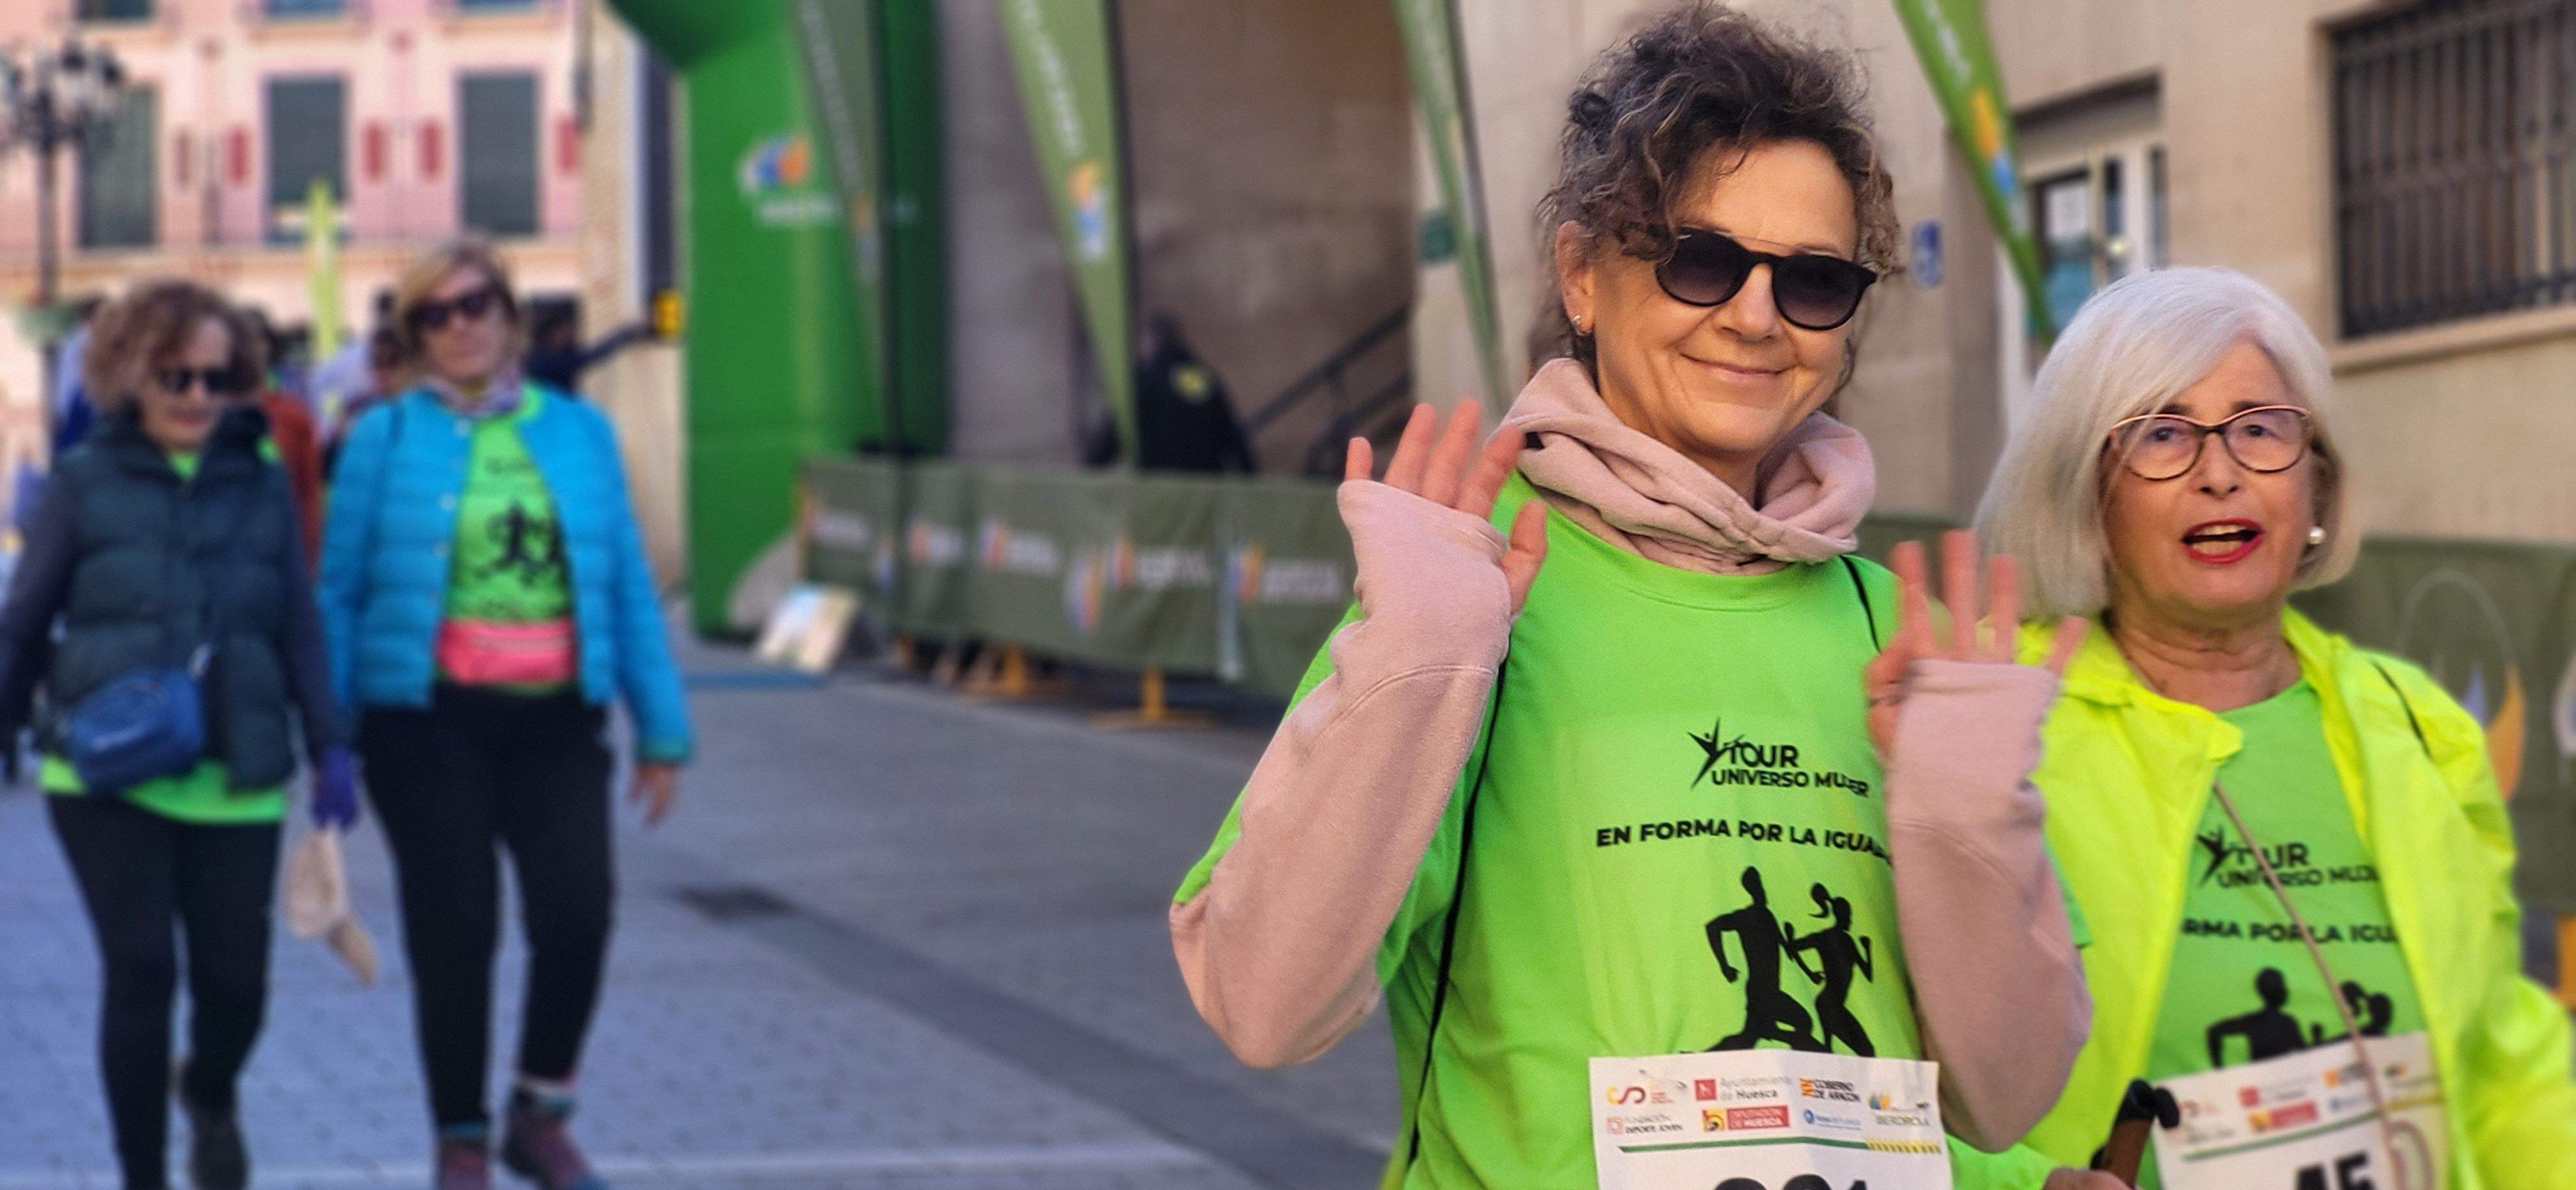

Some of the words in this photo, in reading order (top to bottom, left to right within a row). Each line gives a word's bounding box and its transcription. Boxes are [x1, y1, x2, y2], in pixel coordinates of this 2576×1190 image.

[1724, 739, 1799, 768] TOUR
[1712, 770, 1809, 788] UNIVERSO
[1596, 826, 1632, 847] EN
[1640, 818, 1731, 842] FORMA
[1738, 820, 1782, 842] POR
[1790, 826, 1817, 847] LA
